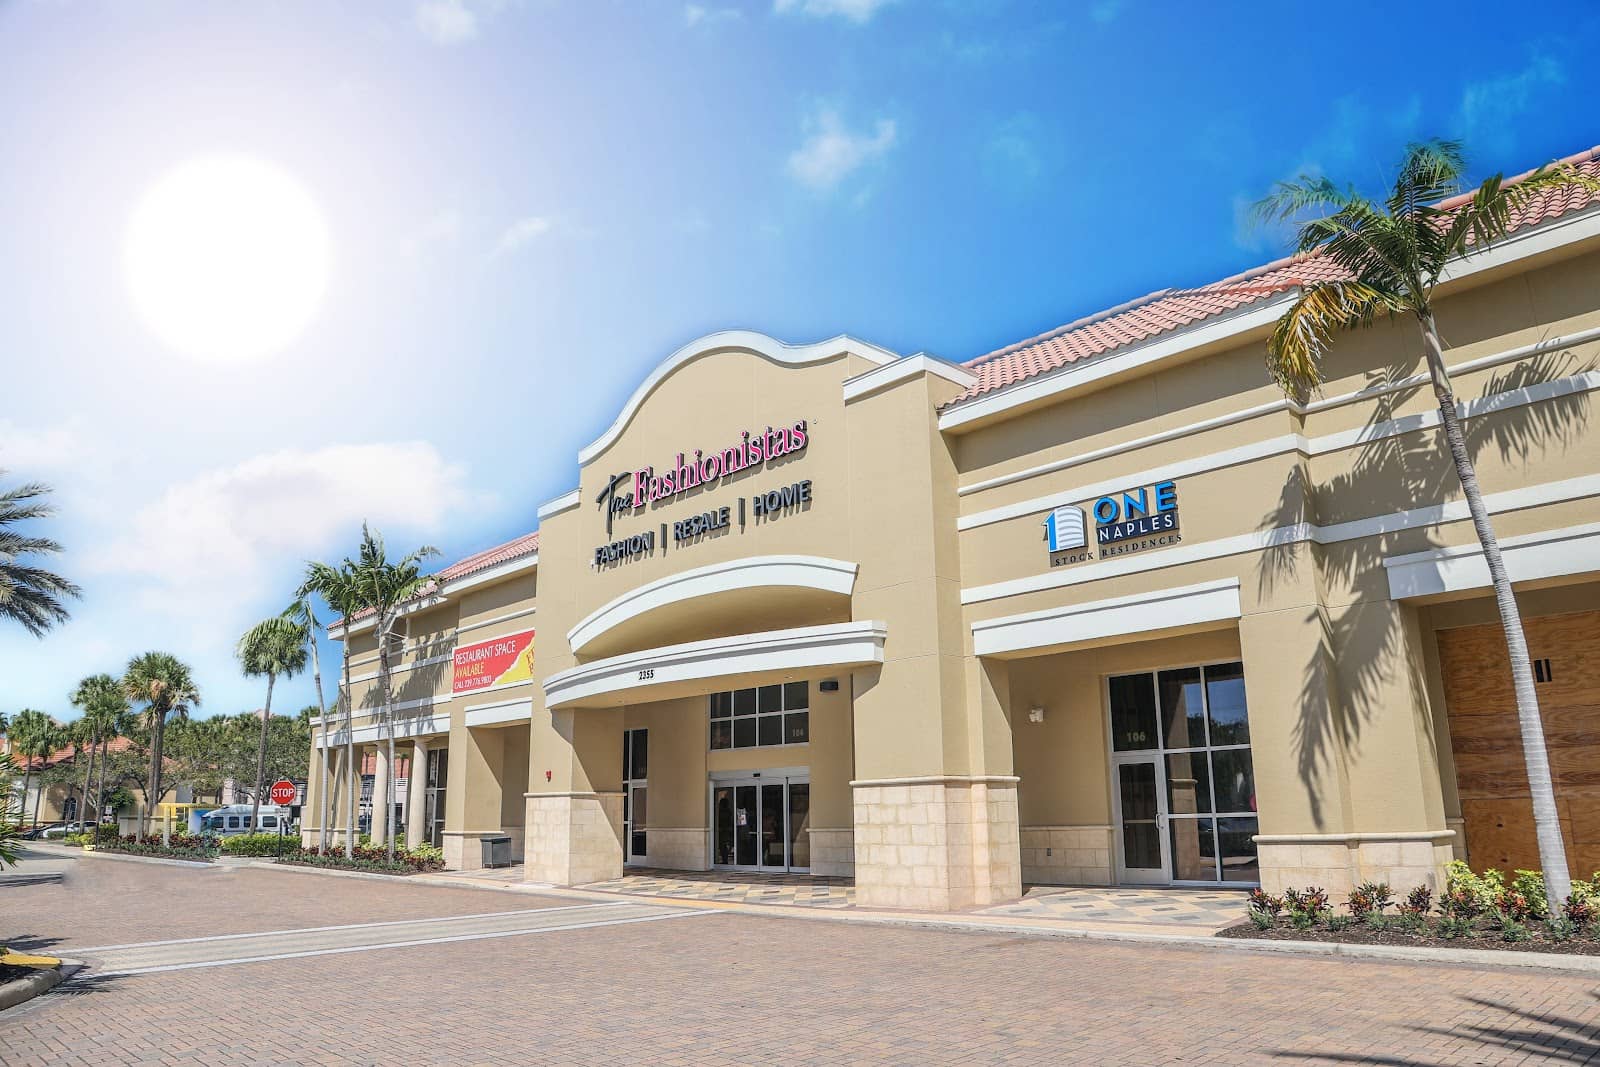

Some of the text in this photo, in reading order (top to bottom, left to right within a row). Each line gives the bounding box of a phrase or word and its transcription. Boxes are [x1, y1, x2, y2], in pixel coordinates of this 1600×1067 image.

[632, 419, 808, 508] Fashionistas
[1093, 481, 1176, 524] ONE
[595, 480, 812, 565] FASHION RESALE HOME
[1099, 514, 1174, 541] NAPLES
[1055, 534, 1182, 566] STOCK RESIDENCES
[455, 640, 516, 665] RESTAURANT SPACE
[638, 669, 654, 681] 2355
[1126, 731, 1146, 743] 106
[272, 788, 294, 798] STOP
